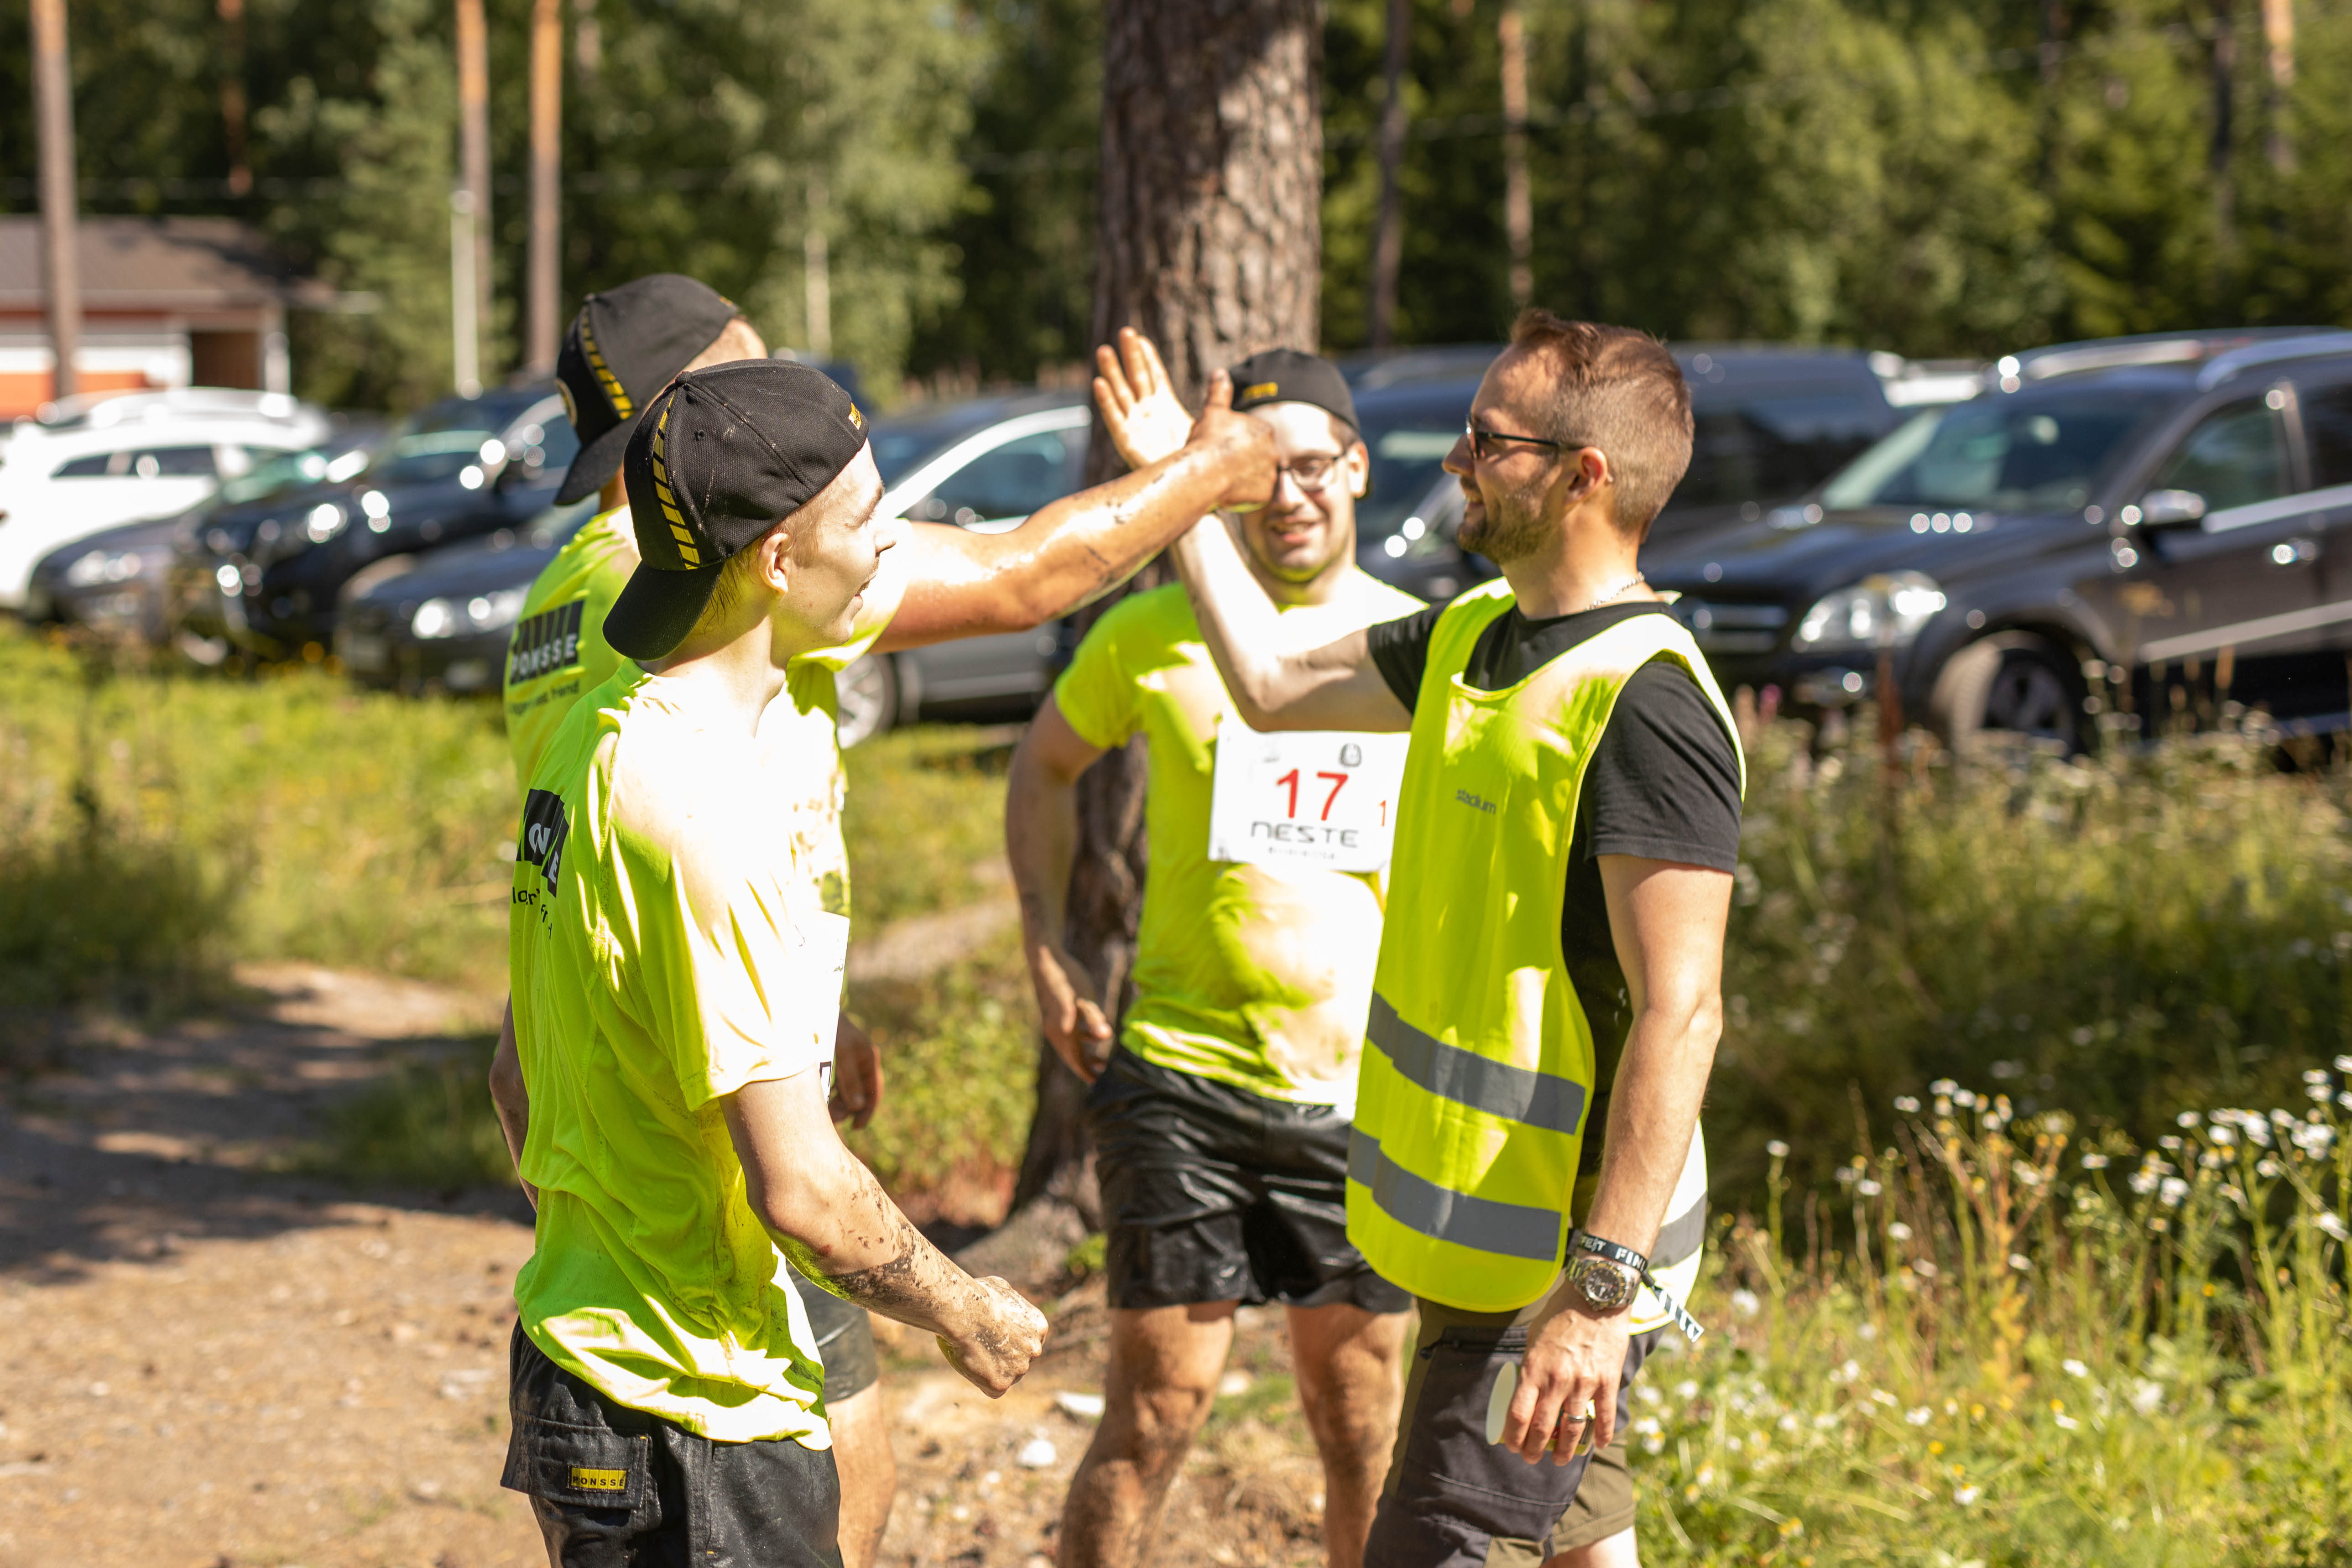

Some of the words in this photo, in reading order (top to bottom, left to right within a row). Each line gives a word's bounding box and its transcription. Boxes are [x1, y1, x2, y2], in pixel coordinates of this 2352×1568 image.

[1276, 768, 1349, 821] 17
[1455, 789, 1497, 815] stadium
[573, 1475, 625, 1487] PONSSE
